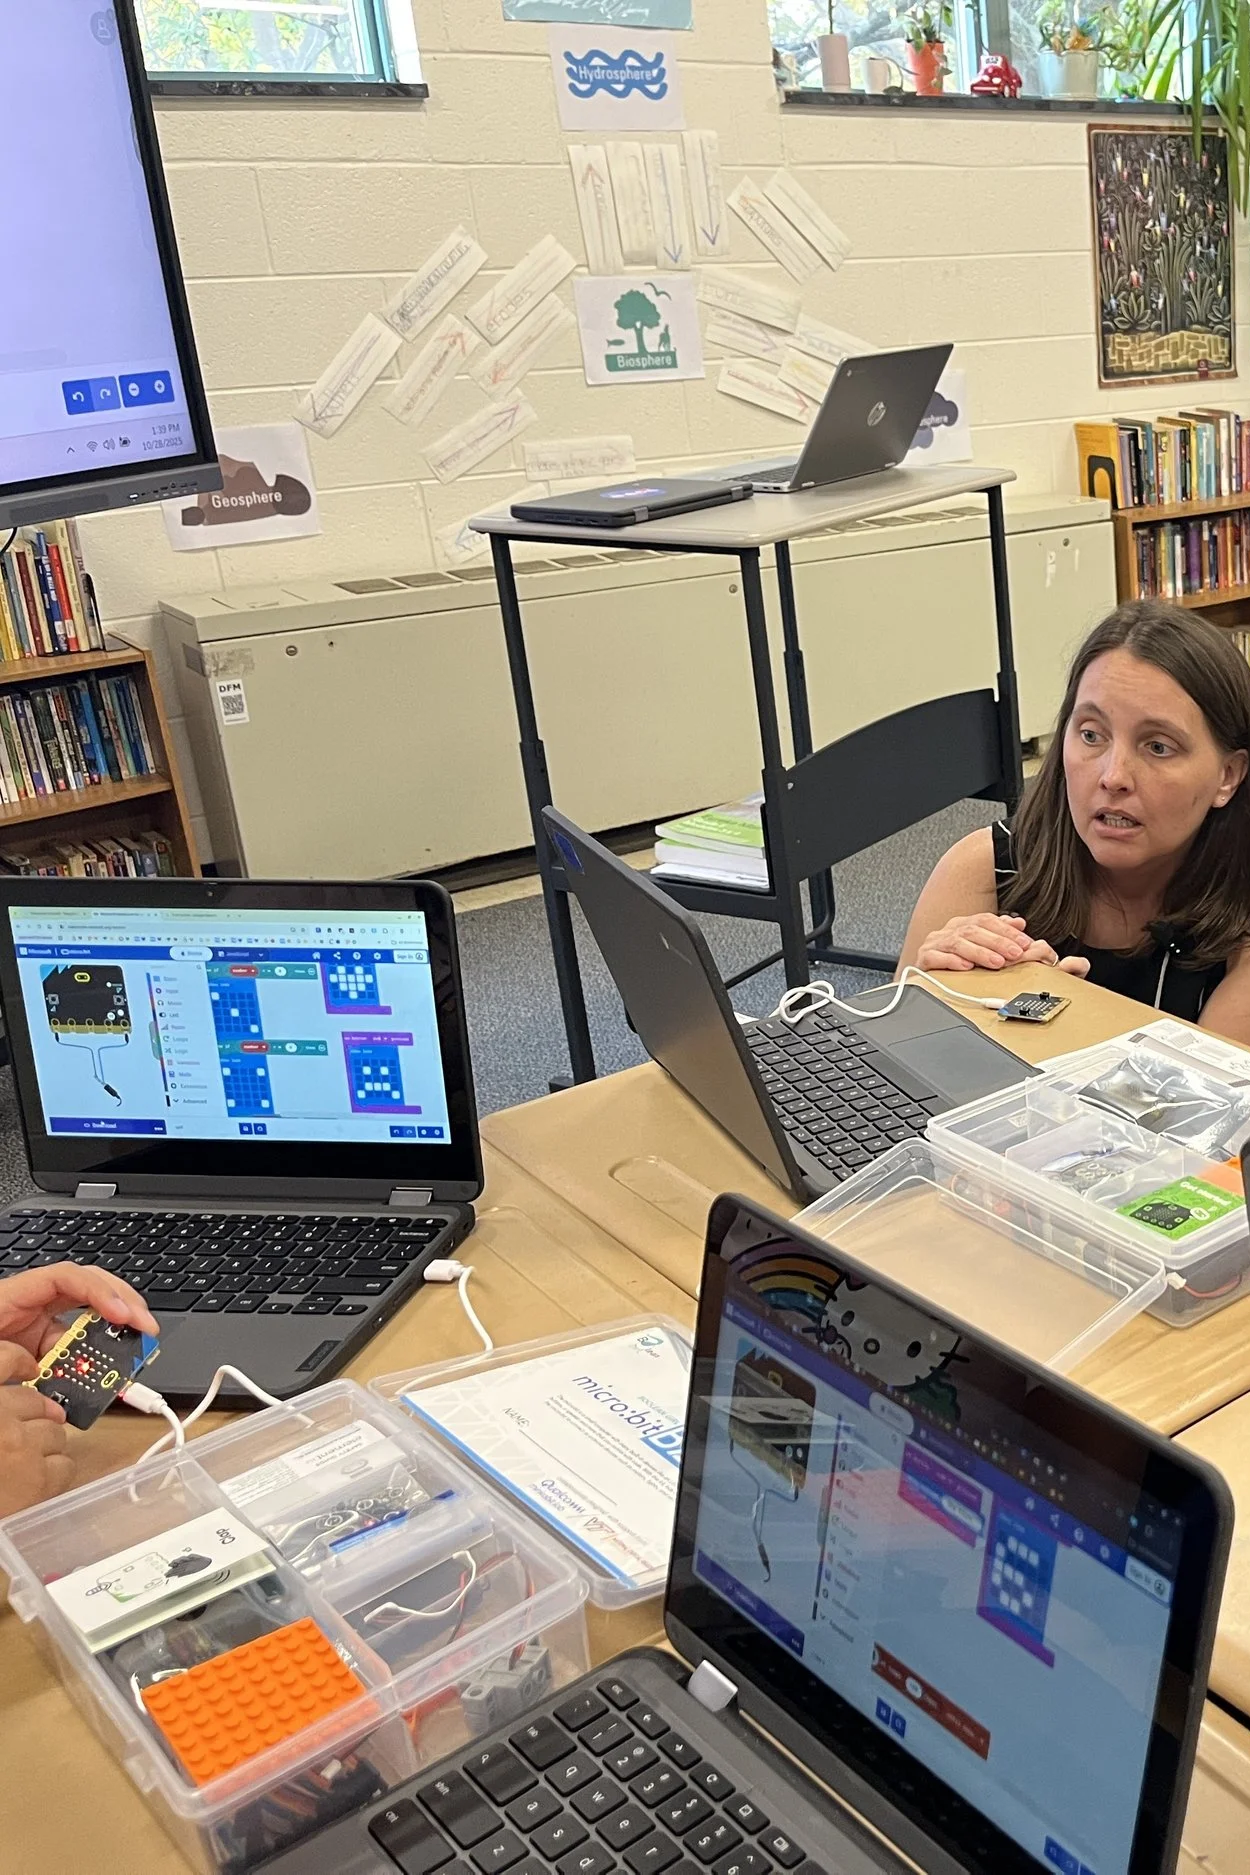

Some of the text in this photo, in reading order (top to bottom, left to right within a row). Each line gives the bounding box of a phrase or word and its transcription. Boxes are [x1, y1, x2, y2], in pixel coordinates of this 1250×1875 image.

[578, 65, 653, 84] Hydrosphere
[616, 350, 673, 371] Biosphere
[151, 424, 180, 436] 1:39 PM
[211, 489, 283, 509] Geosphere
[218, 683, 242, 694] DFM
[572, 1374, 665, 1437] micro:bit
[540, 1478, 586, 1515] Qualcomm
